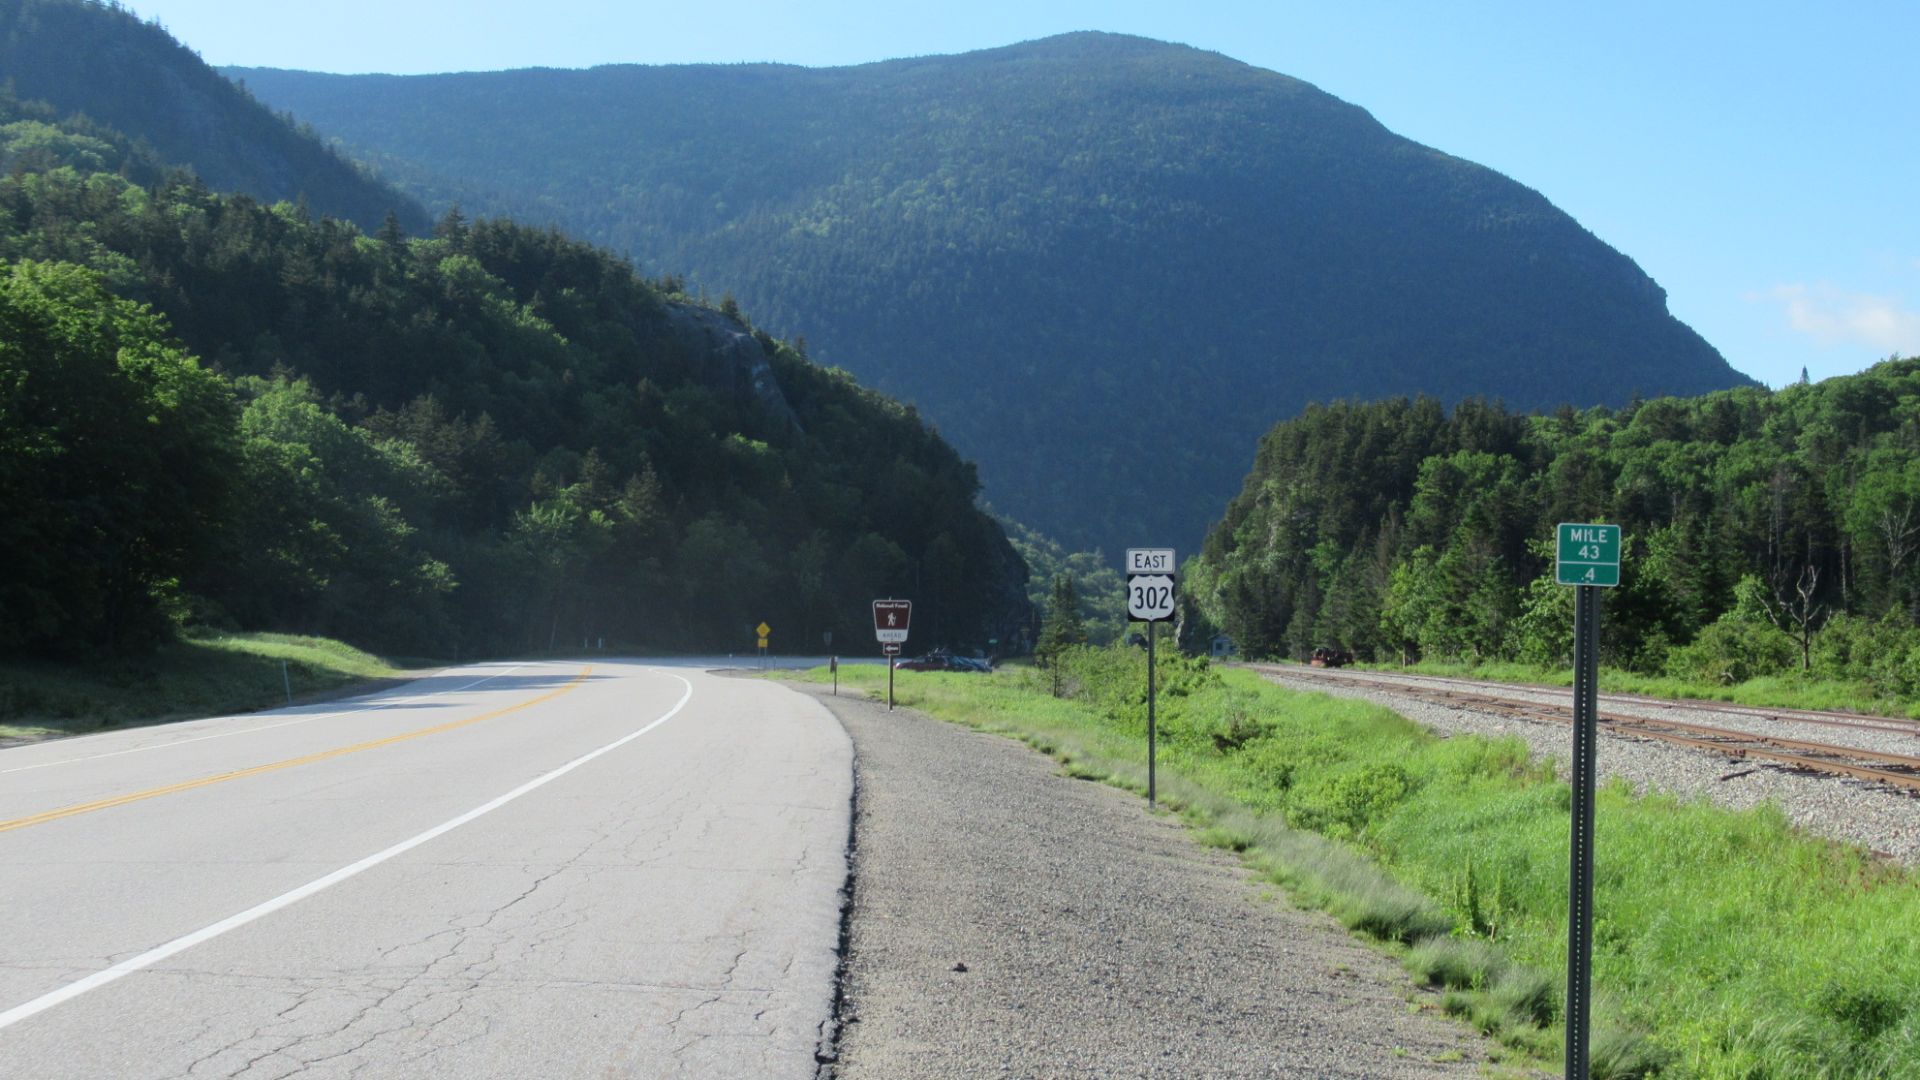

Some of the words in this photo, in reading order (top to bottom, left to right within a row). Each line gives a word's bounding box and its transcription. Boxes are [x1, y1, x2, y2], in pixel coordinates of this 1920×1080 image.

[1571, 528, 1607, 542] MILE
[1578, 545, 1600, 559] 43
[1135, 553, 1166, 568] EAST
[1134, 586, 1169, 610] 302
